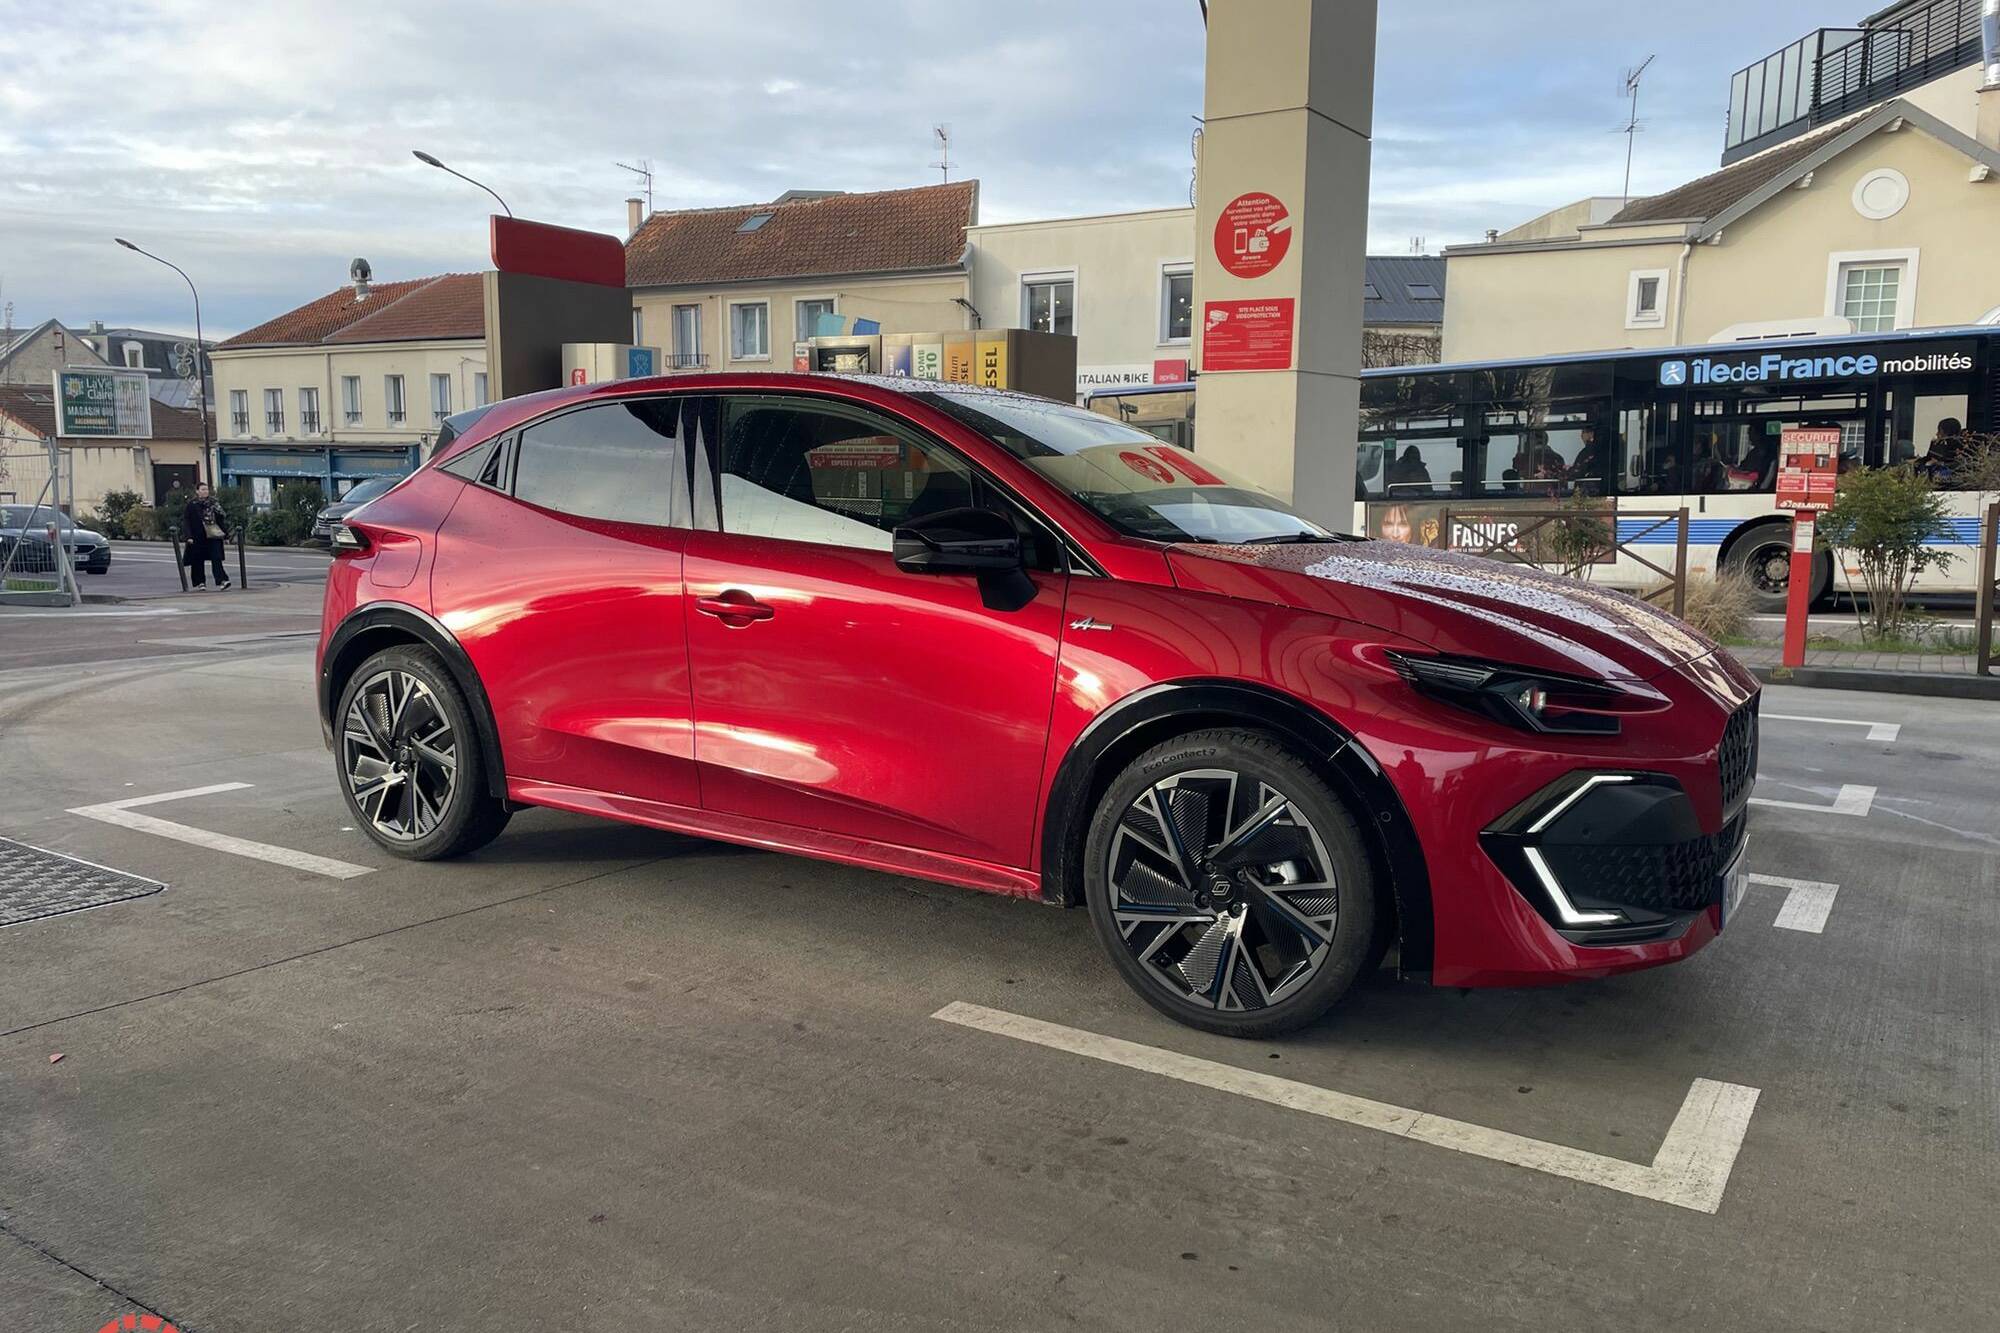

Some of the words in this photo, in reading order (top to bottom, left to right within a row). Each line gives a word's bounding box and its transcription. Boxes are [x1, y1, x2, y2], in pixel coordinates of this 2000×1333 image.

[1882, 351, 1973, 373] mobilités
[1078, 374, 1121, 384] ITALIAN
[1123, 373, 1149, 383] BIKE
[87, 389, 113, 400] Claire
[67, 406, 101, 416] MAGASIN
[1143, 749, 1207, 774] EcoContact
